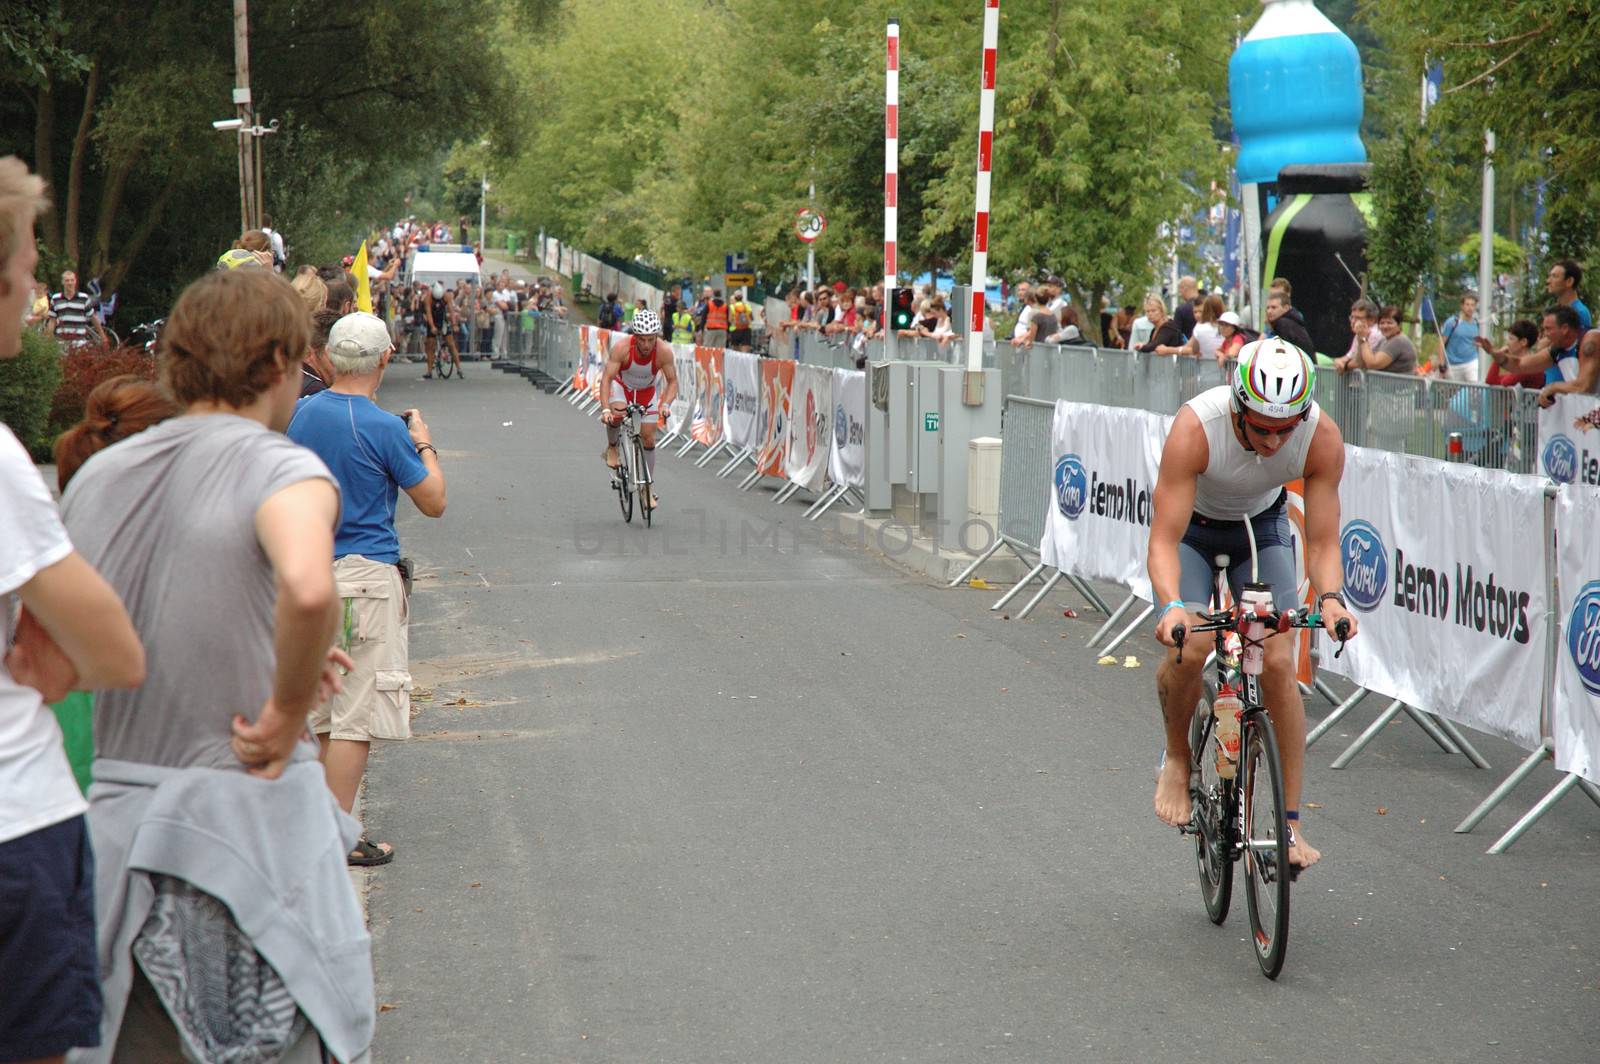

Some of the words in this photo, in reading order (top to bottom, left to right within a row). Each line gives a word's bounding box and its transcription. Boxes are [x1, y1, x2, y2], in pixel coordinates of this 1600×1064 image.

[1582, 448, 1600, 486] Be
[1346, 533, 1379, 597] Ford
[1455, 562, 1530, 645] Motors
